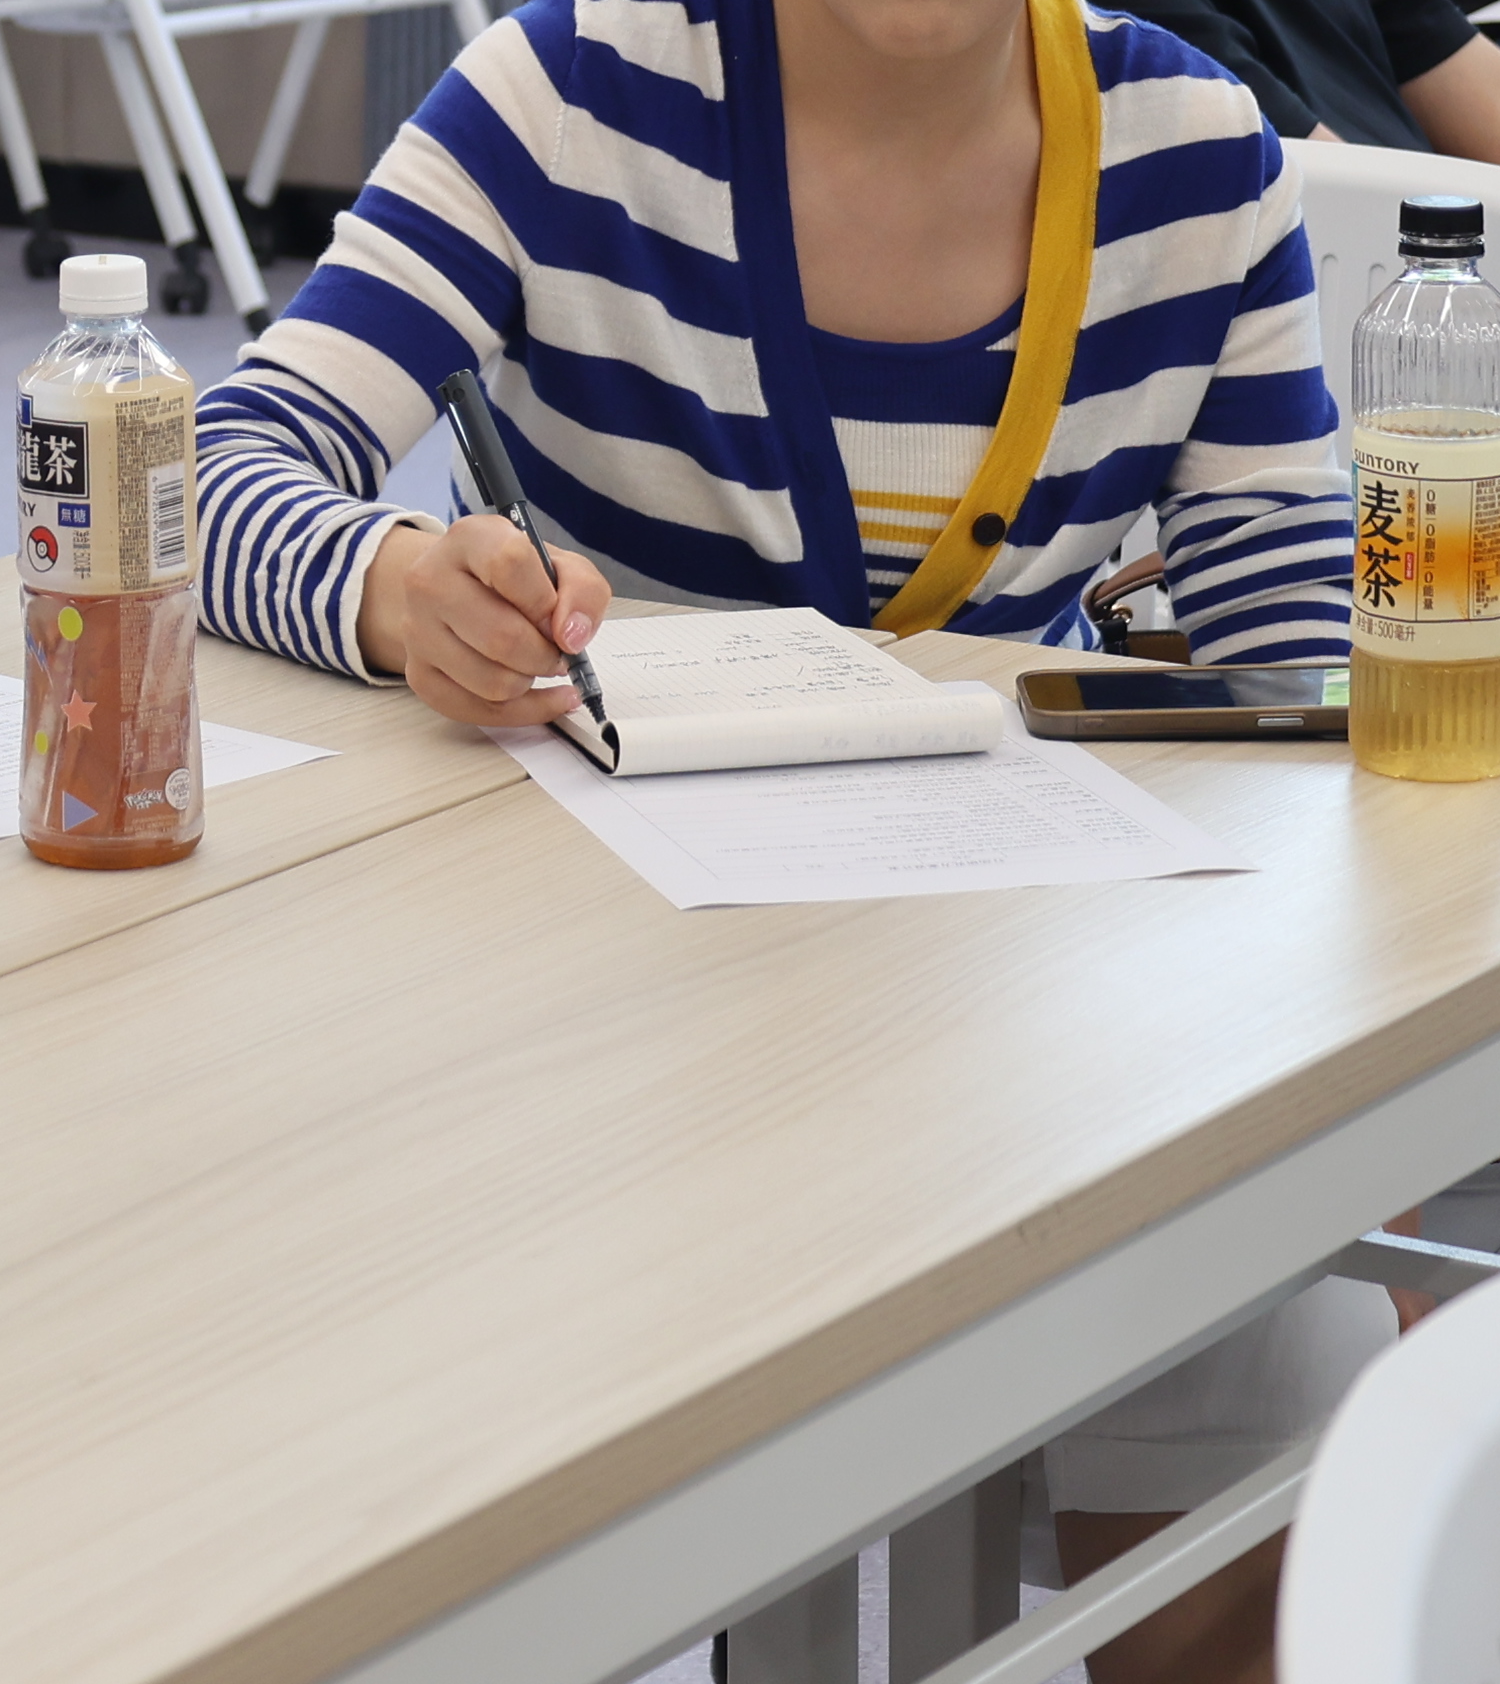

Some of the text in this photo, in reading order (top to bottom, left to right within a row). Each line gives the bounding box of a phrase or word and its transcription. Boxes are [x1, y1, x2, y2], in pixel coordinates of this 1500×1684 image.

[1354, 448, 1420, 475] SUNTORY
[61, 508, 87, 524] 無糖
[1360, 480, 1404, 608] 麦茶
